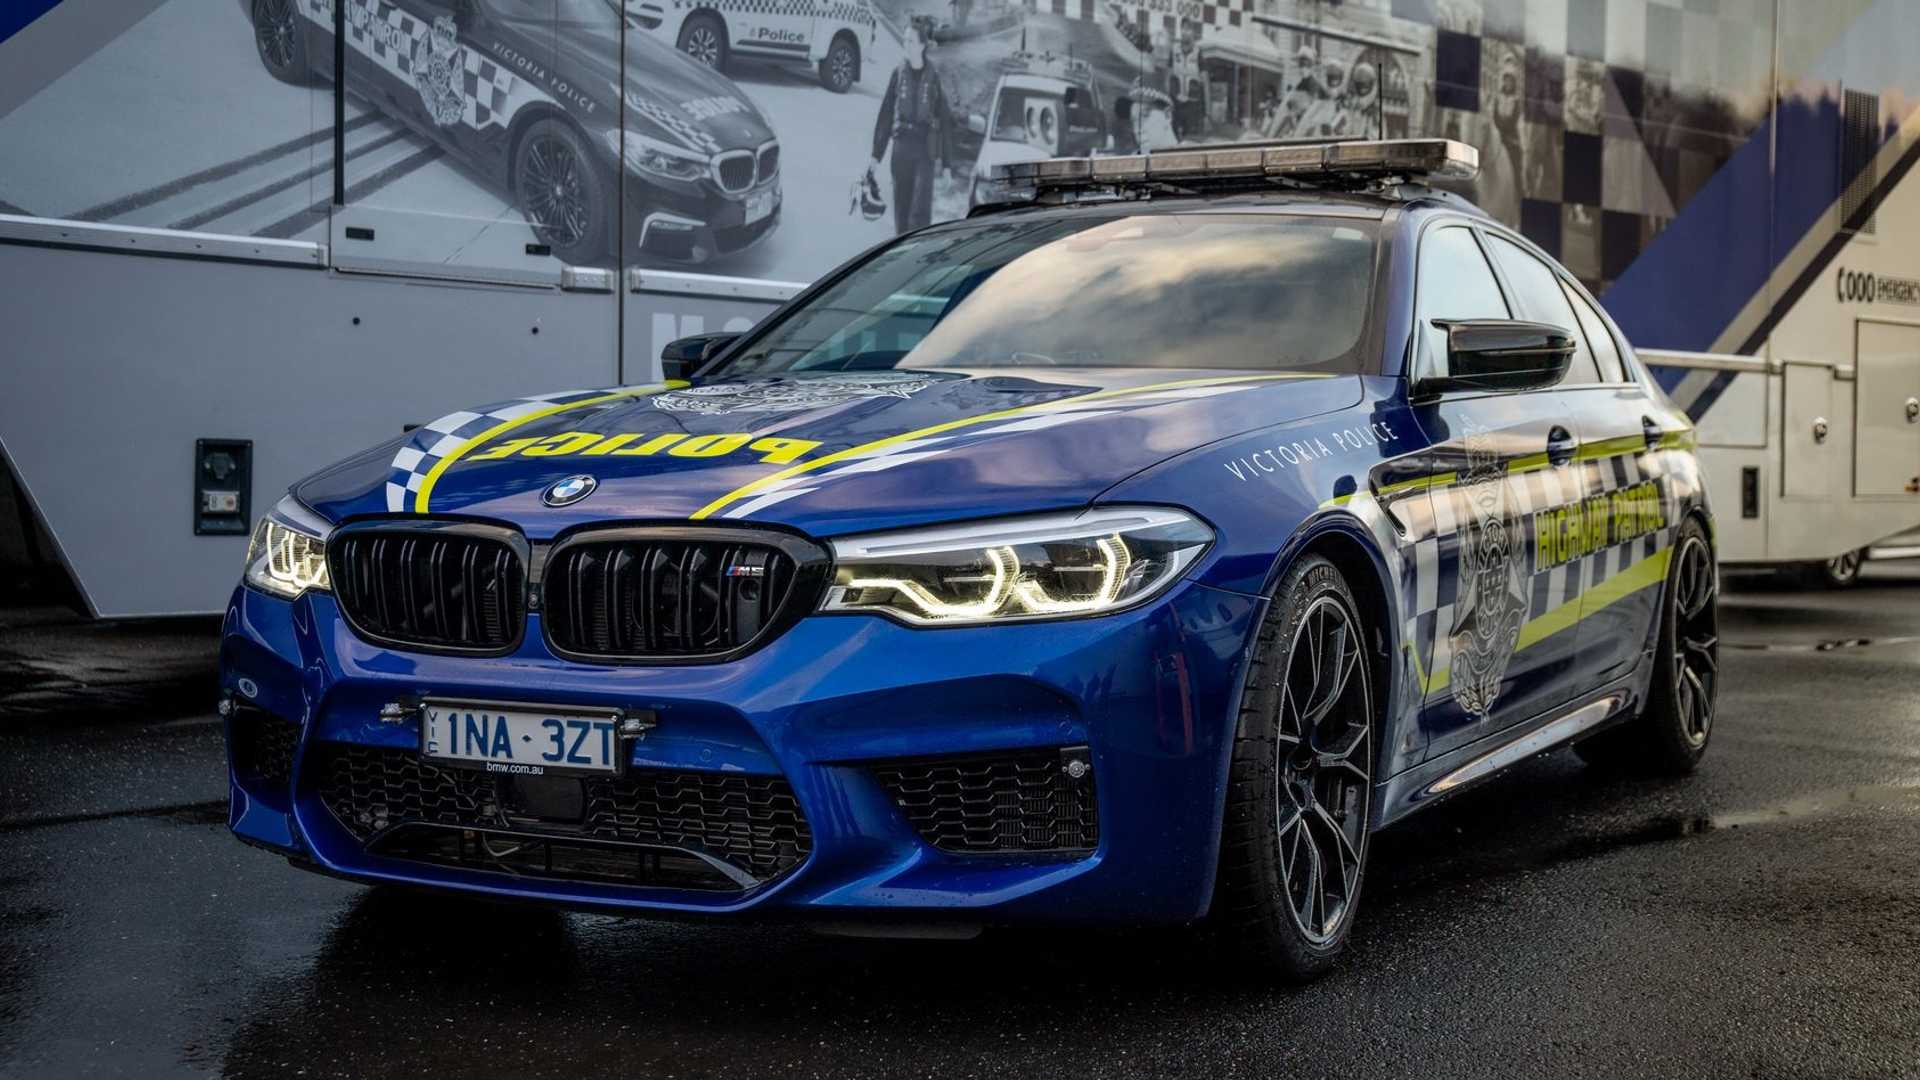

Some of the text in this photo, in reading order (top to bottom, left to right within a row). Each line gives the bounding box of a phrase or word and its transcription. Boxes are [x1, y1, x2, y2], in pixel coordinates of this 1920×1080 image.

[758, 26, 805, 42] Police
[493, 42, 596, 113] VICTORIA POLICE
[1877, 278, 1920, 304] EMERGENC
[1223, 421, 1399, 482] VICTORIA POLICE
[1535, 480, 1665, 573] HIGHWAY PATROL
[736, 565, 765, 577] M5
[427, 710, 439, 755] VIC
[486, 761, 545, 775] bmw.com.au
